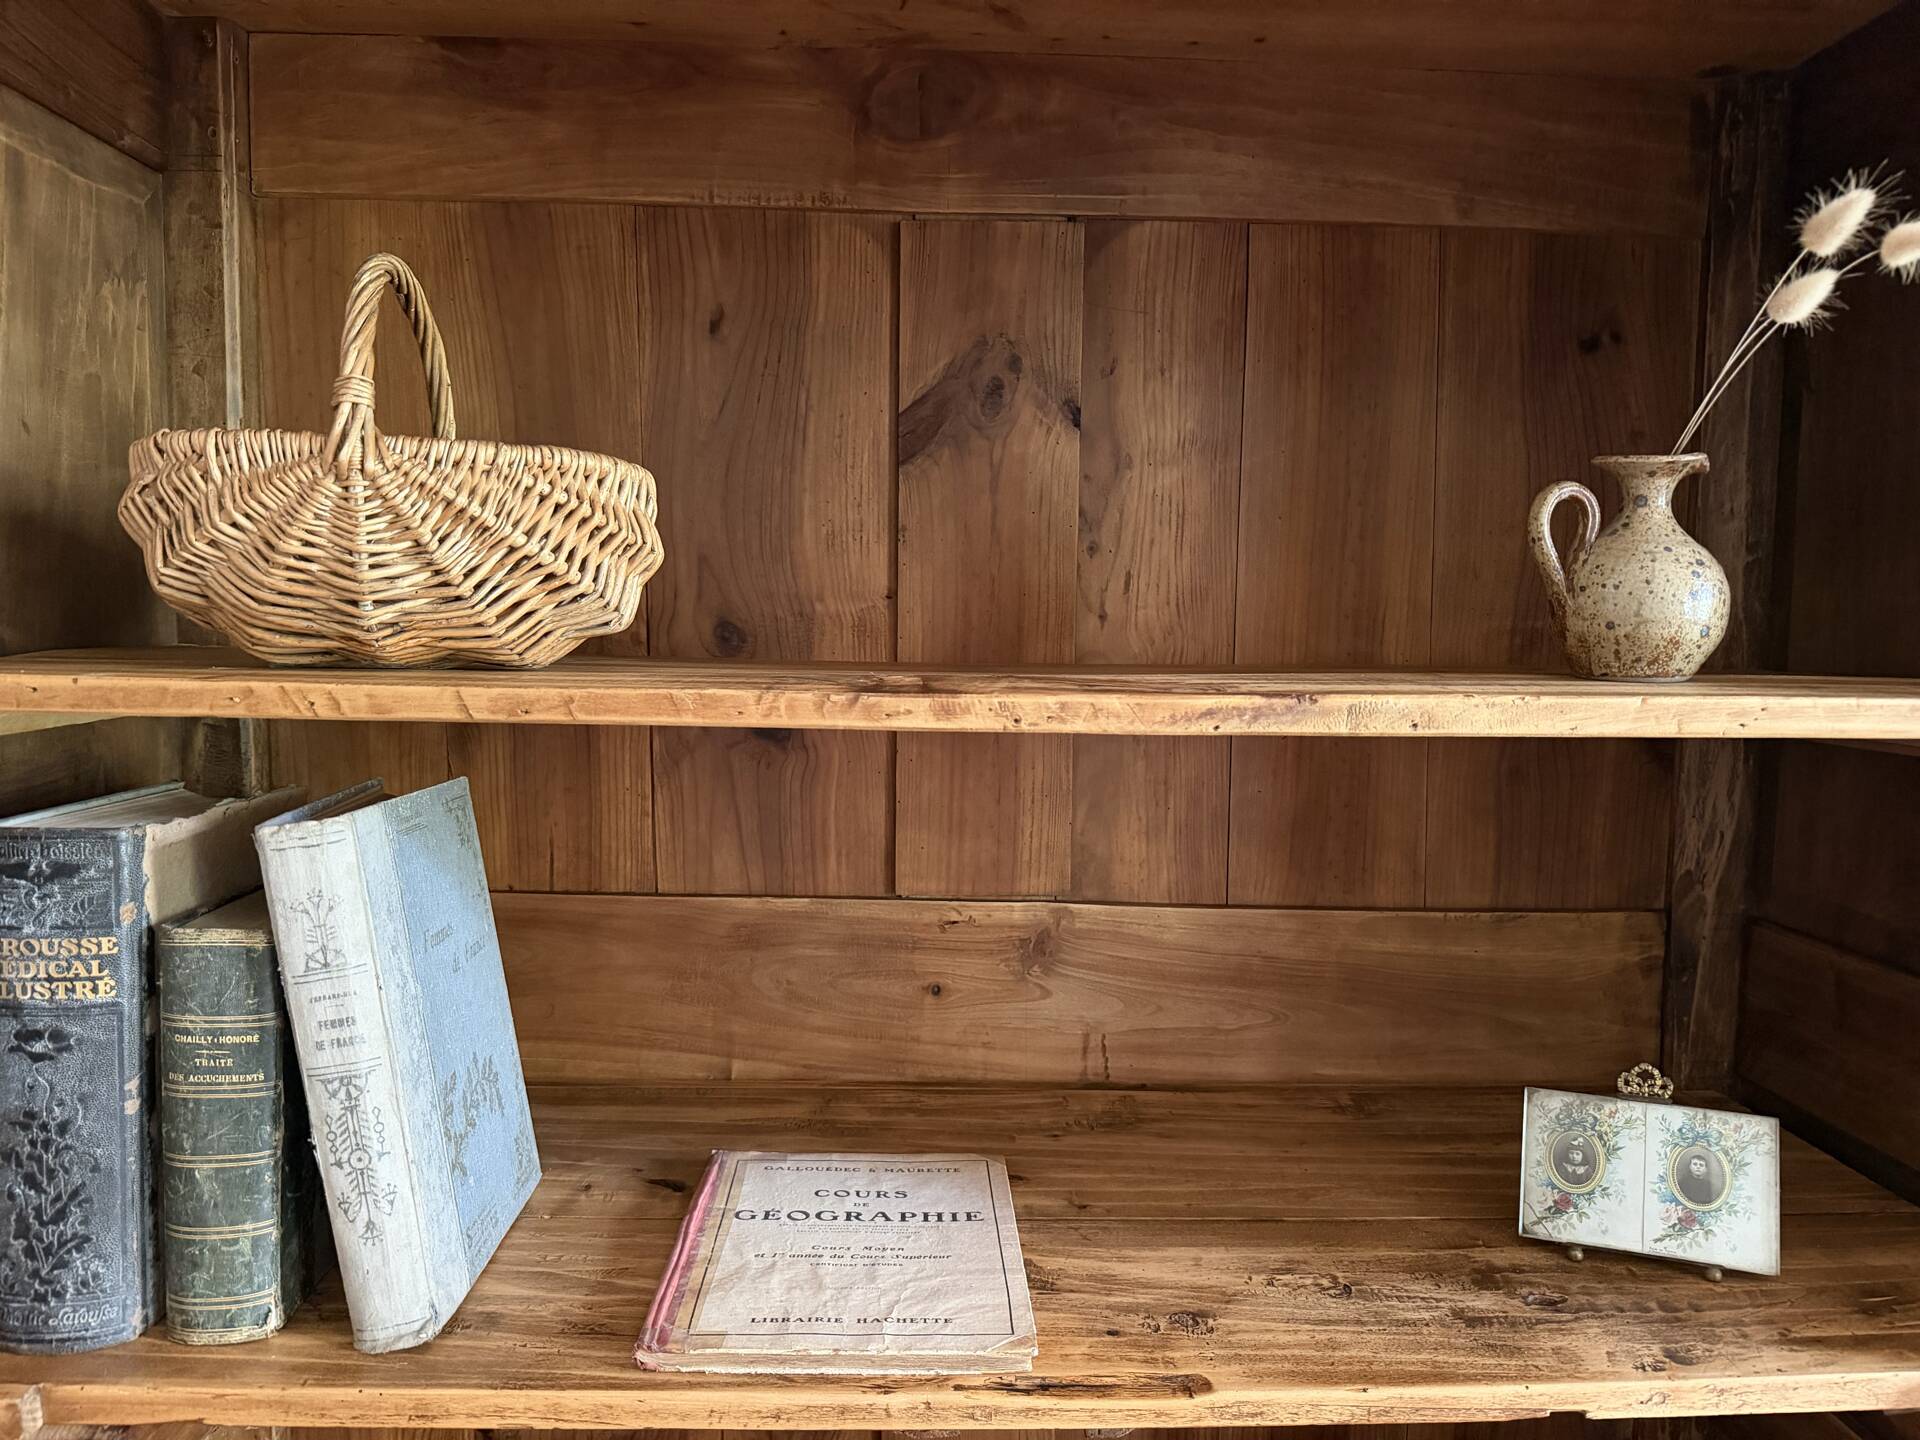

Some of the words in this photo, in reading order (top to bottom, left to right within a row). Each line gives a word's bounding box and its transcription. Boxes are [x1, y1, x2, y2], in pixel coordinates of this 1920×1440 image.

[1, 937, 119, 957] ROUSSE
[814, 1189, 908, 1199] COURS
[734, 1207, 985, 1222] GÉOGRAPHIE
[750, 1316, 844, 1324] LIBRAIRIE
[856, 1316, 953, 1324] HACHETTE
